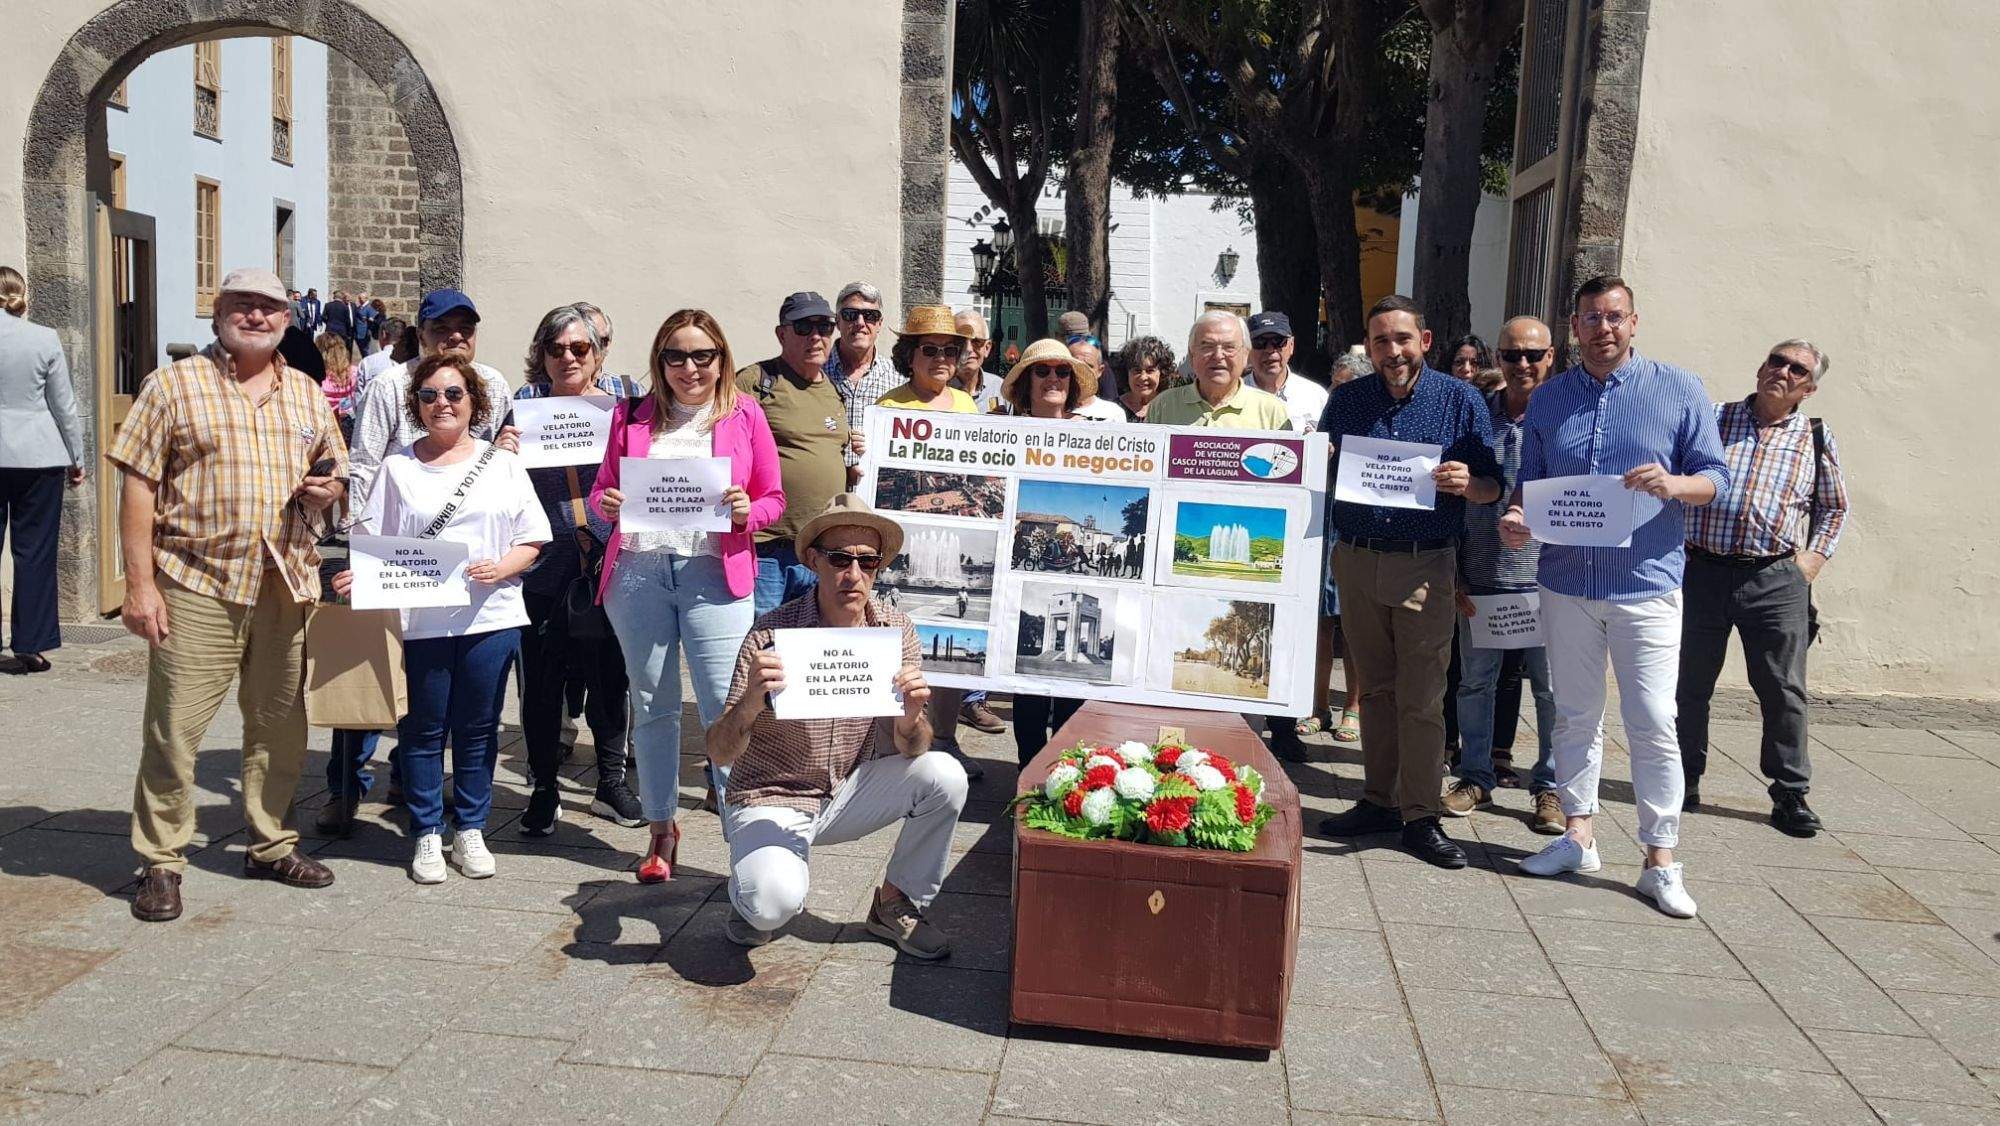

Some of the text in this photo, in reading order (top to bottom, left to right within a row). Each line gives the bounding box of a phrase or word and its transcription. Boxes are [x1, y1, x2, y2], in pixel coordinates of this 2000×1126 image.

[1045, 186, 1062, 199] LA
[543, 421, 591, 431] VELATORIO
[892, 417, 1156, 453] NO a un velatorio en la Plaza del Cristo
[562, 440, 593, 449] CRISTO
[1193, 441, 1240, 450] ASOCIACIÓN
[889, 440, 1153, 474] La Plaza es ocio No negocio
[1195, 450, 1240, 459] DE VECINOS
[1172, 457, 1239, 468] CASCO HISTÓRICO
[474, 464, 484, 472] Y
[1184, 467, 1194, 475] DE
[1206, 468, 1239, 477] LAGUNA
[1365, 462, 1411, 473] VELATORIO
[454, 470, 479, 497] LOLA
[1387, 475, 1413, 483] PLAZA
[1380, 483, 1410, 492] CRISTO
[1552, 500, 1603, 508] VELATORIO
[424, 502, 456, 536] BIMBA
[1570, 520, 1603, 528] CRISTO
[1488, 610, 1531, 620] VELATORIO
[1511, 618, 1536, 626] PLAZA
[1507, 626, 1535, 635] CRISTO
[809, 661, 869, 670] VELATORIO
[806, 675, 819, 683] EN
[839, 674, 873, 682] PLAZA
[809, 687, 870, 696] DEL CRISTO
